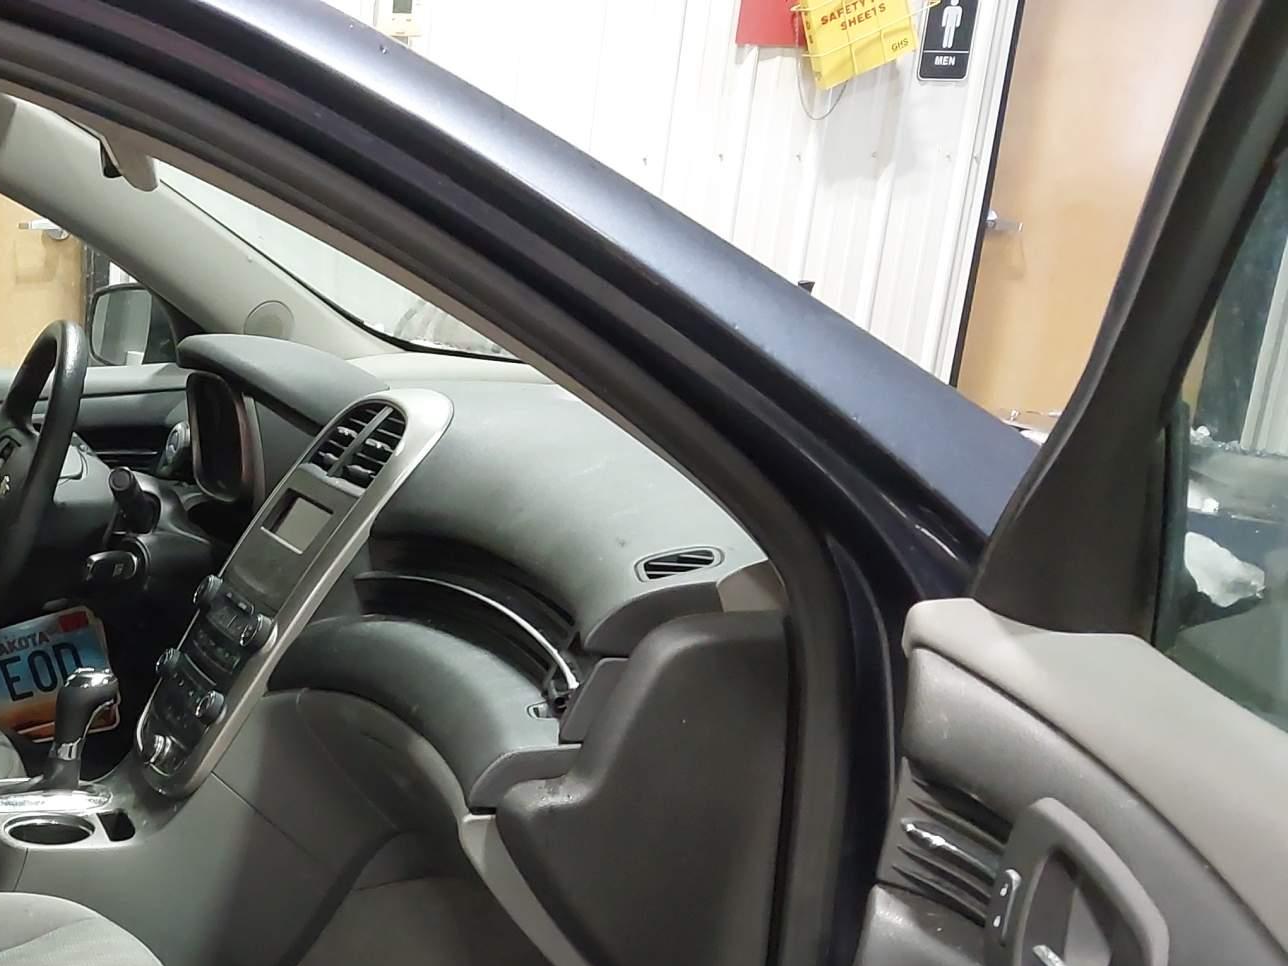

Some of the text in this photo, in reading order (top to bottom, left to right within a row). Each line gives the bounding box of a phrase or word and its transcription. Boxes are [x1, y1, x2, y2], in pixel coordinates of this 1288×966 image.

[820, 0, 866, 25] SAFETY
[840, 3, 887, 31] SHEETS
[934, 55, 956, 66] MEN
